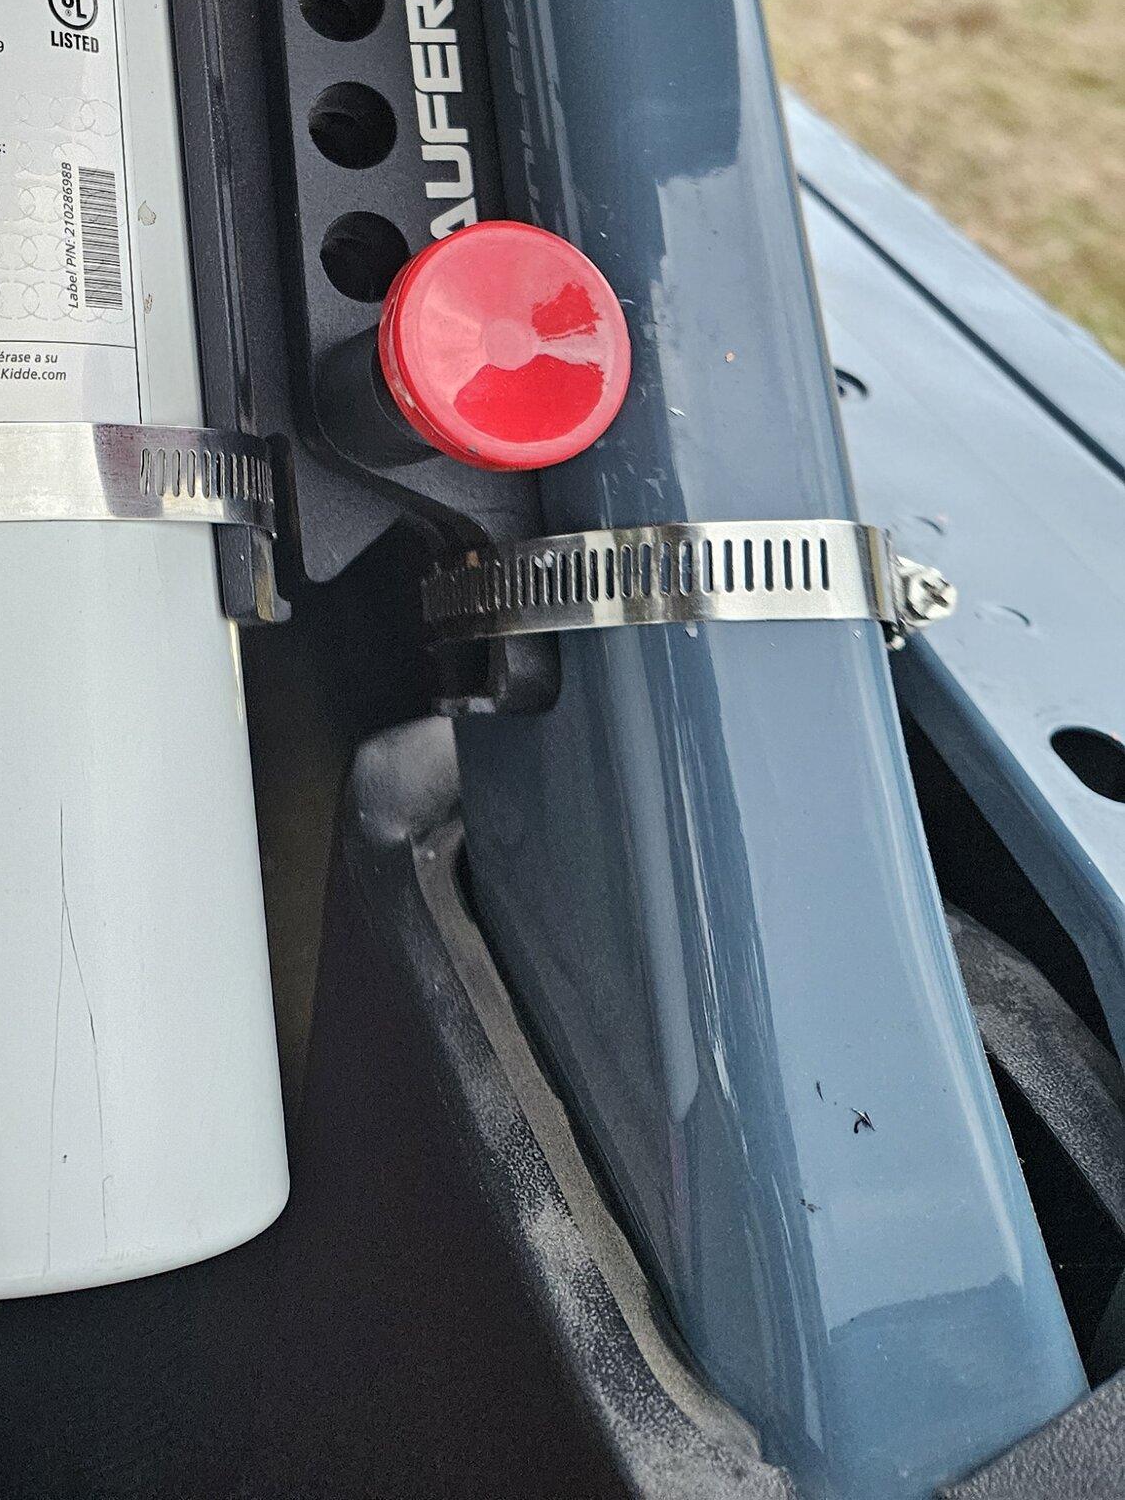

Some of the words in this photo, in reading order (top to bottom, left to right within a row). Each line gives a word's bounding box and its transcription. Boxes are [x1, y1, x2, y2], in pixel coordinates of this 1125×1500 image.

[49, 29, 100, 54] LISTED
[60, 161, 76, 238] 21028698B
[65, 237, 78, 268] P/N:
[65, 270, 79, 309] Label
[33, 353, 42, 364] a
[44, 353, 59, 364] su
